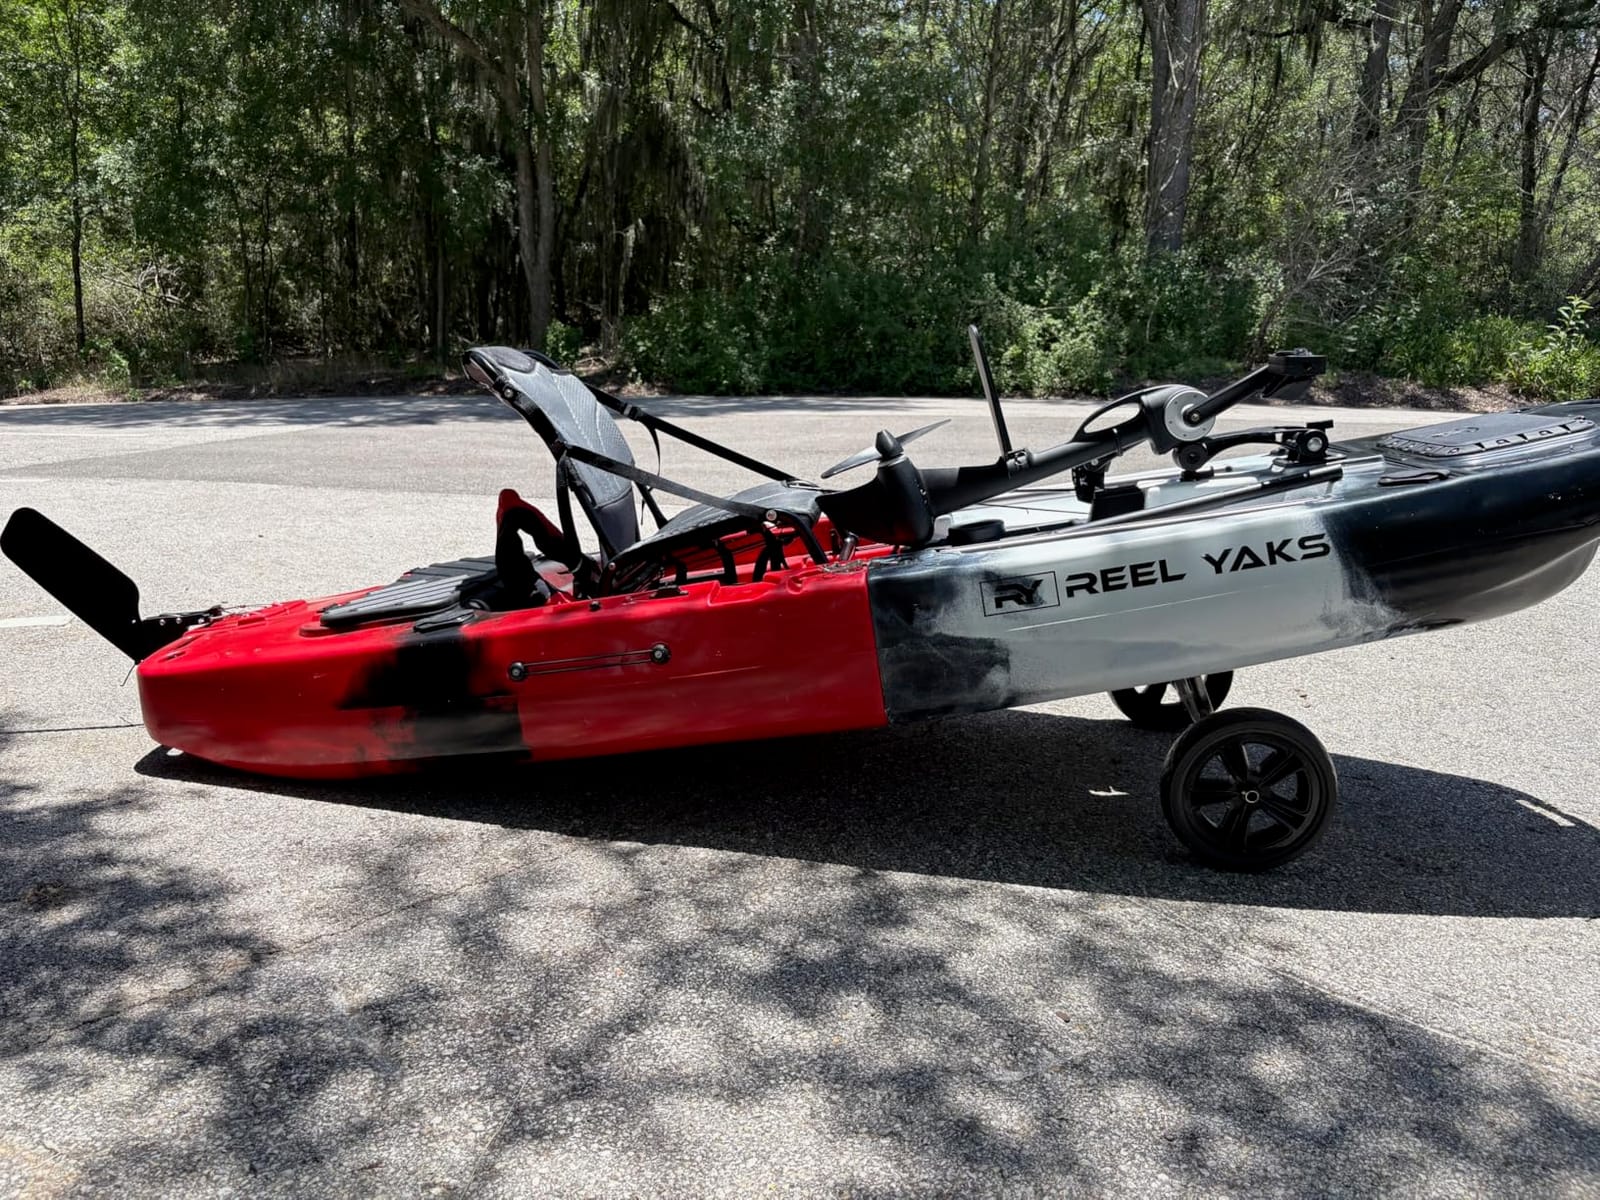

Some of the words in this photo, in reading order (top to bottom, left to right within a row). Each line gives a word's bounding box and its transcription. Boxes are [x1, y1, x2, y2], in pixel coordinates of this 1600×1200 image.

[994, 579, 1043, 609] RY
[1065, 559, 1187, 598] REEL
[1201, 533, 1331, 575] YAKS
